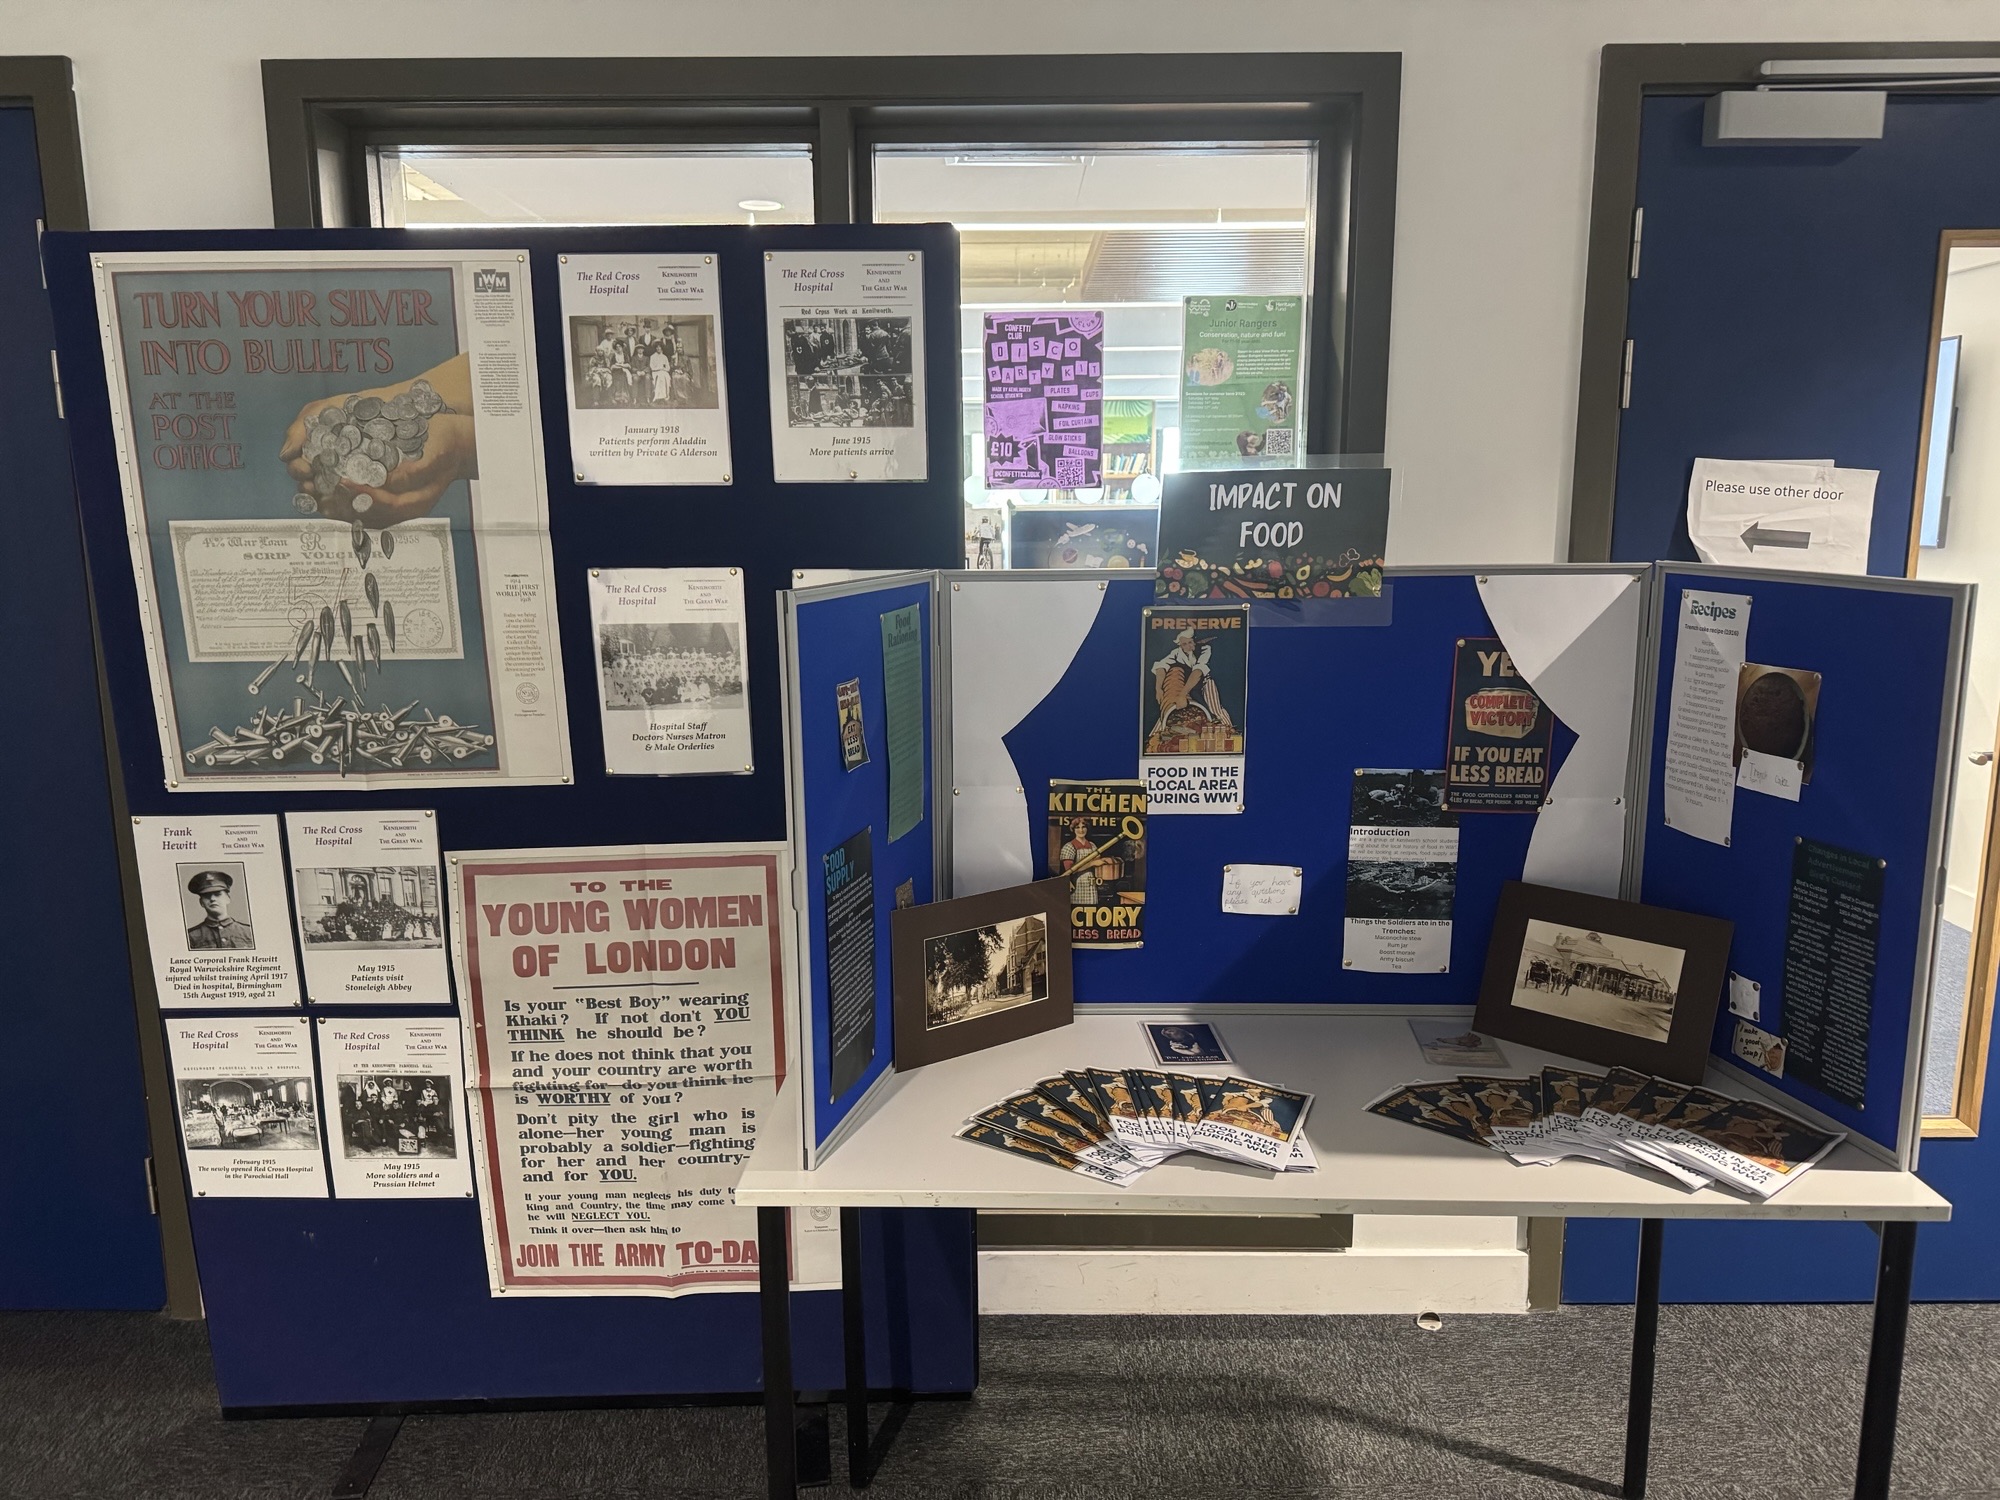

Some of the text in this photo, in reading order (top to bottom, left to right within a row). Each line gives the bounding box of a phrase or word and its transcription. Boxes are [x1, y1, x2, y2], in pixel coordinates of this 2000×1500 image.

[479, 274, 506, 292] IWM
[577, 271, 640, 281] The Red Cross
[589, 284, 629, 296] Hospital
[133, 291, 222, 330] TURN
[226, 290, 326, 328] YOUR
[328, 289, 439, 327] SILVER
[1005, 324, 1031, 332] CONFETTI
[1209, 319, 1277, 329] Junior Rangers
[1008, 332, 1022, 340] CLUB
[997, 341, 1078, 357] DISCO
[141, 338, 394, 376] INTO BULLETS
[991, 364, 1098, 380] PARTY KIT
[150, 391, 236, 410] AT THE
[153, 413, 236, 441] POST
[625, 426, 658, 435] January
[599, 437, 707, 447] Patients perform Aladdin
[832, 436, 871, 446] June 1915
[624, 449, 634, 459] by
[637, 449, 668, 457] Private
[680, 448, 717, 457] Alderson
[809, 447, 894, 458] More patients arrive
[991, 442, 1013, 457] £10
[1068, 448, 1094, 456] BALLOONS
[153, 443, 245, 471] OFFICE
[1209, 481, 1342, 511] IMPACT ON
[1705, 480, 1844, 500] Please use other door
[1239, 521, 1304, 548] FOOD
[1691, 600, 1736, 621] Recipes
[896, 612, 910, 629] Food
[1151, 617, 1241, 630] PRESERVE
[888, 626, 917, 648] Rationing
[1477, 651, 1523, 677] YE
[1470, 694, 1534, 710] COMPLETE
[1469, 710, 1536, 726] VICTORY
[650, 721, 707, 732] Hospital Staff
[848, 724, 856, 734] EAT
[632, 732, 726, 742] Doctors Nurses Matron
[848, 734, 858, 746] LESS
[645, 742, 715, 752] & Male Orderlies
[848, 745, 860, 757] BREAD
[1454, 746, 1544, 763] IF YOU EAT
[1147, 766, 1239, 778] FOOD IN THE
[1450, 764, 1544, 784] LESS BREAD
[1148, 779, 1238, 791] LOCAL AREA
[1049, 793, 1147, 813] KITCHEN
[1147, 792, 1238, 804] DURING WW1
[1059, 816, 1116, 826] IS THE
[164, 827, 192, 837] Frank
[1350, 828, 1410, 837] Introduction
[162, 841, 197, 850] Hewitt
[824, 847, 845, 872] FOOD
[826, 859, 855, 896] SUPPLY
[1088, 876, 1103, 886] TO
[1272, 876, 1291, 885] have
[570, 879, 672, 893] TO THE
[1227, 890, 1242, 899] any
[1225, 898, 1248, 907] please
[482, 894, 763, 937] YOUNG WOMEN
[1071, 907, 1141, 928] CTORY
[1073, 928, 1141, 940] LESS BREAD
[194, 957, 226, 965] Corporal
[512, 937, 736, 978] OF LONDON
[166, 975, 191, 983] injured
[219, 974, 248, 982] training
[504, 1000, 520, 1012] Is
[527, 1001, 567, 1014] your
[679, 992, 749, 1007] wearing
[595, 1012, 608, 1024] If
[621, 1013, 649, 1023] not
[659, 1010, 702, 1023] don't
[714, 1007, 750, 1021] YOU
[507, 1029, 565, 1041] THINK
[576, 1028, 597, 1039] he
[607, 1025, 663, 1040] should
[1744, 1027, 1758, 1036] make
[1744, 1037, 1760, 1048] good
[1742, 1048, 1763, 1062] Soup!
[1229, 1079, 1300, 1100] PRESERVE
[1199, 1127, 1278, 1153] LOCAL AREA
[1201, 1122, 1281, 1148] FOOD IN THE
[1193, 1130, 1277, 1158] DURING WW1
[516, 1240, 759, 1268] JOIN THE ARMY TO-DA
